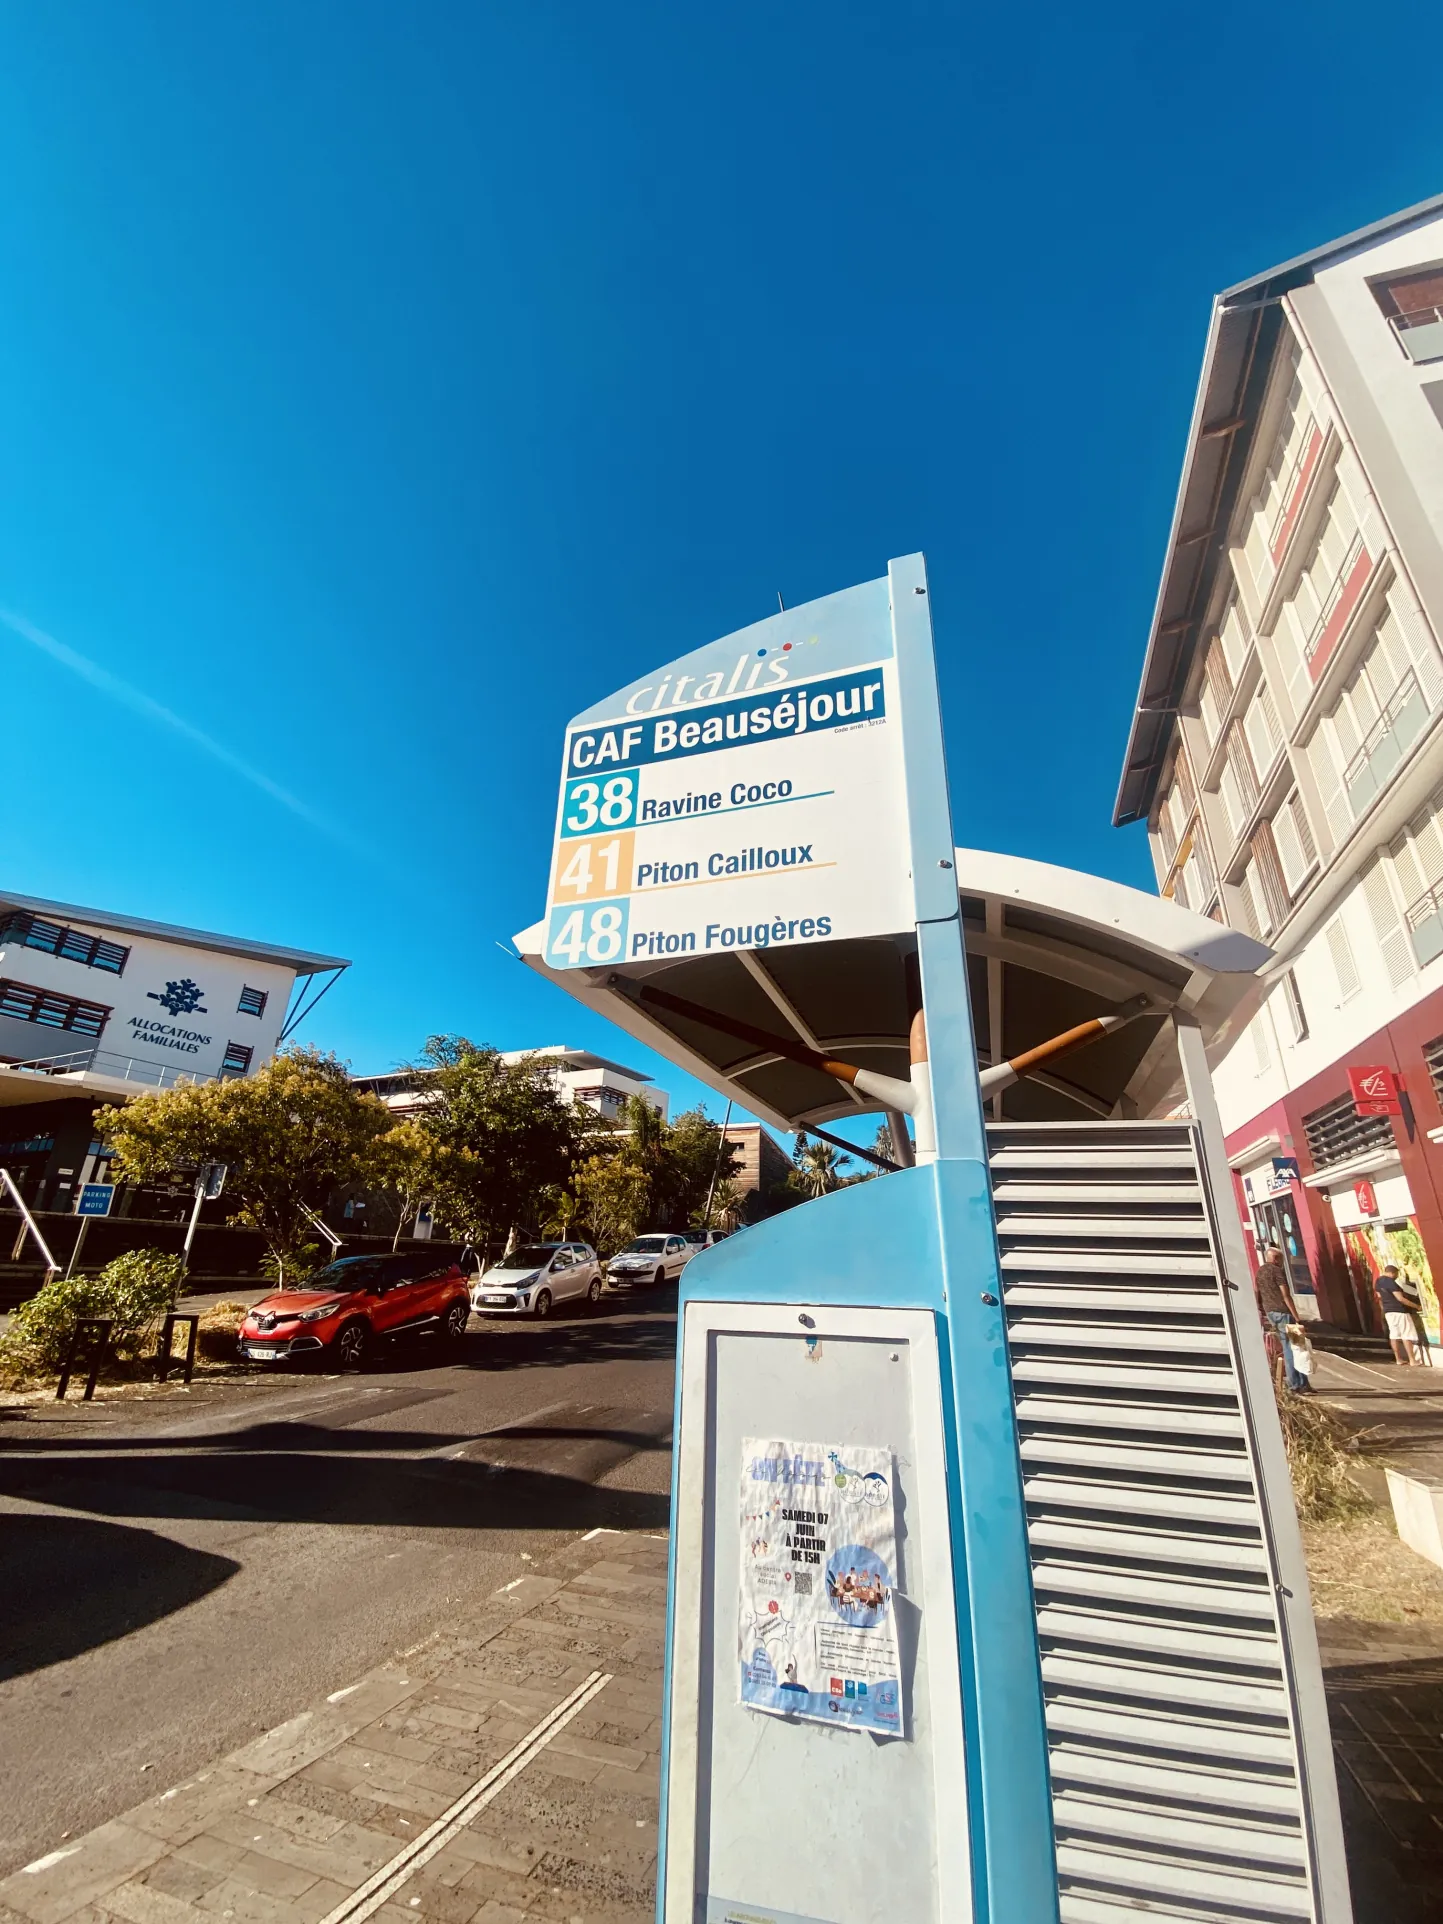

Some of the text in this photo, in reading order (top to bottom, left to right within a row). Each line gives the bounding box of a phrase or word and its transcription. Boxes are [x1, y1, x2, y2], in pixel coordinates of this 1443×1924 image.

[625, 653, 790, 715] citalis
[572, 681, 882, 768] CAF Beauséjour
[566, 776, 633, 832] 38
[641, 778, 793, 821] Ravine Coco
[559, 838, 622, 895] 41
[636, 844, 814, 887] Piton Cailloux
[551, 907, 622, 965] 48
[631, 915, 833, 957] Piton Fougères
[127, 1016, 213, 1045] ALLOCATIONS
[132, 1029, 200, 1054] FAMILIALES
[1275, 1168, 1298, 1178] AXA
[782, 1509, 829, 1525] SAMEDI 07
[796, 1524, 815, 1537] JUIN
[785, 1532, 826, 1552] À PARTIR
[791, 1550, 821, 1565] DE 15H
